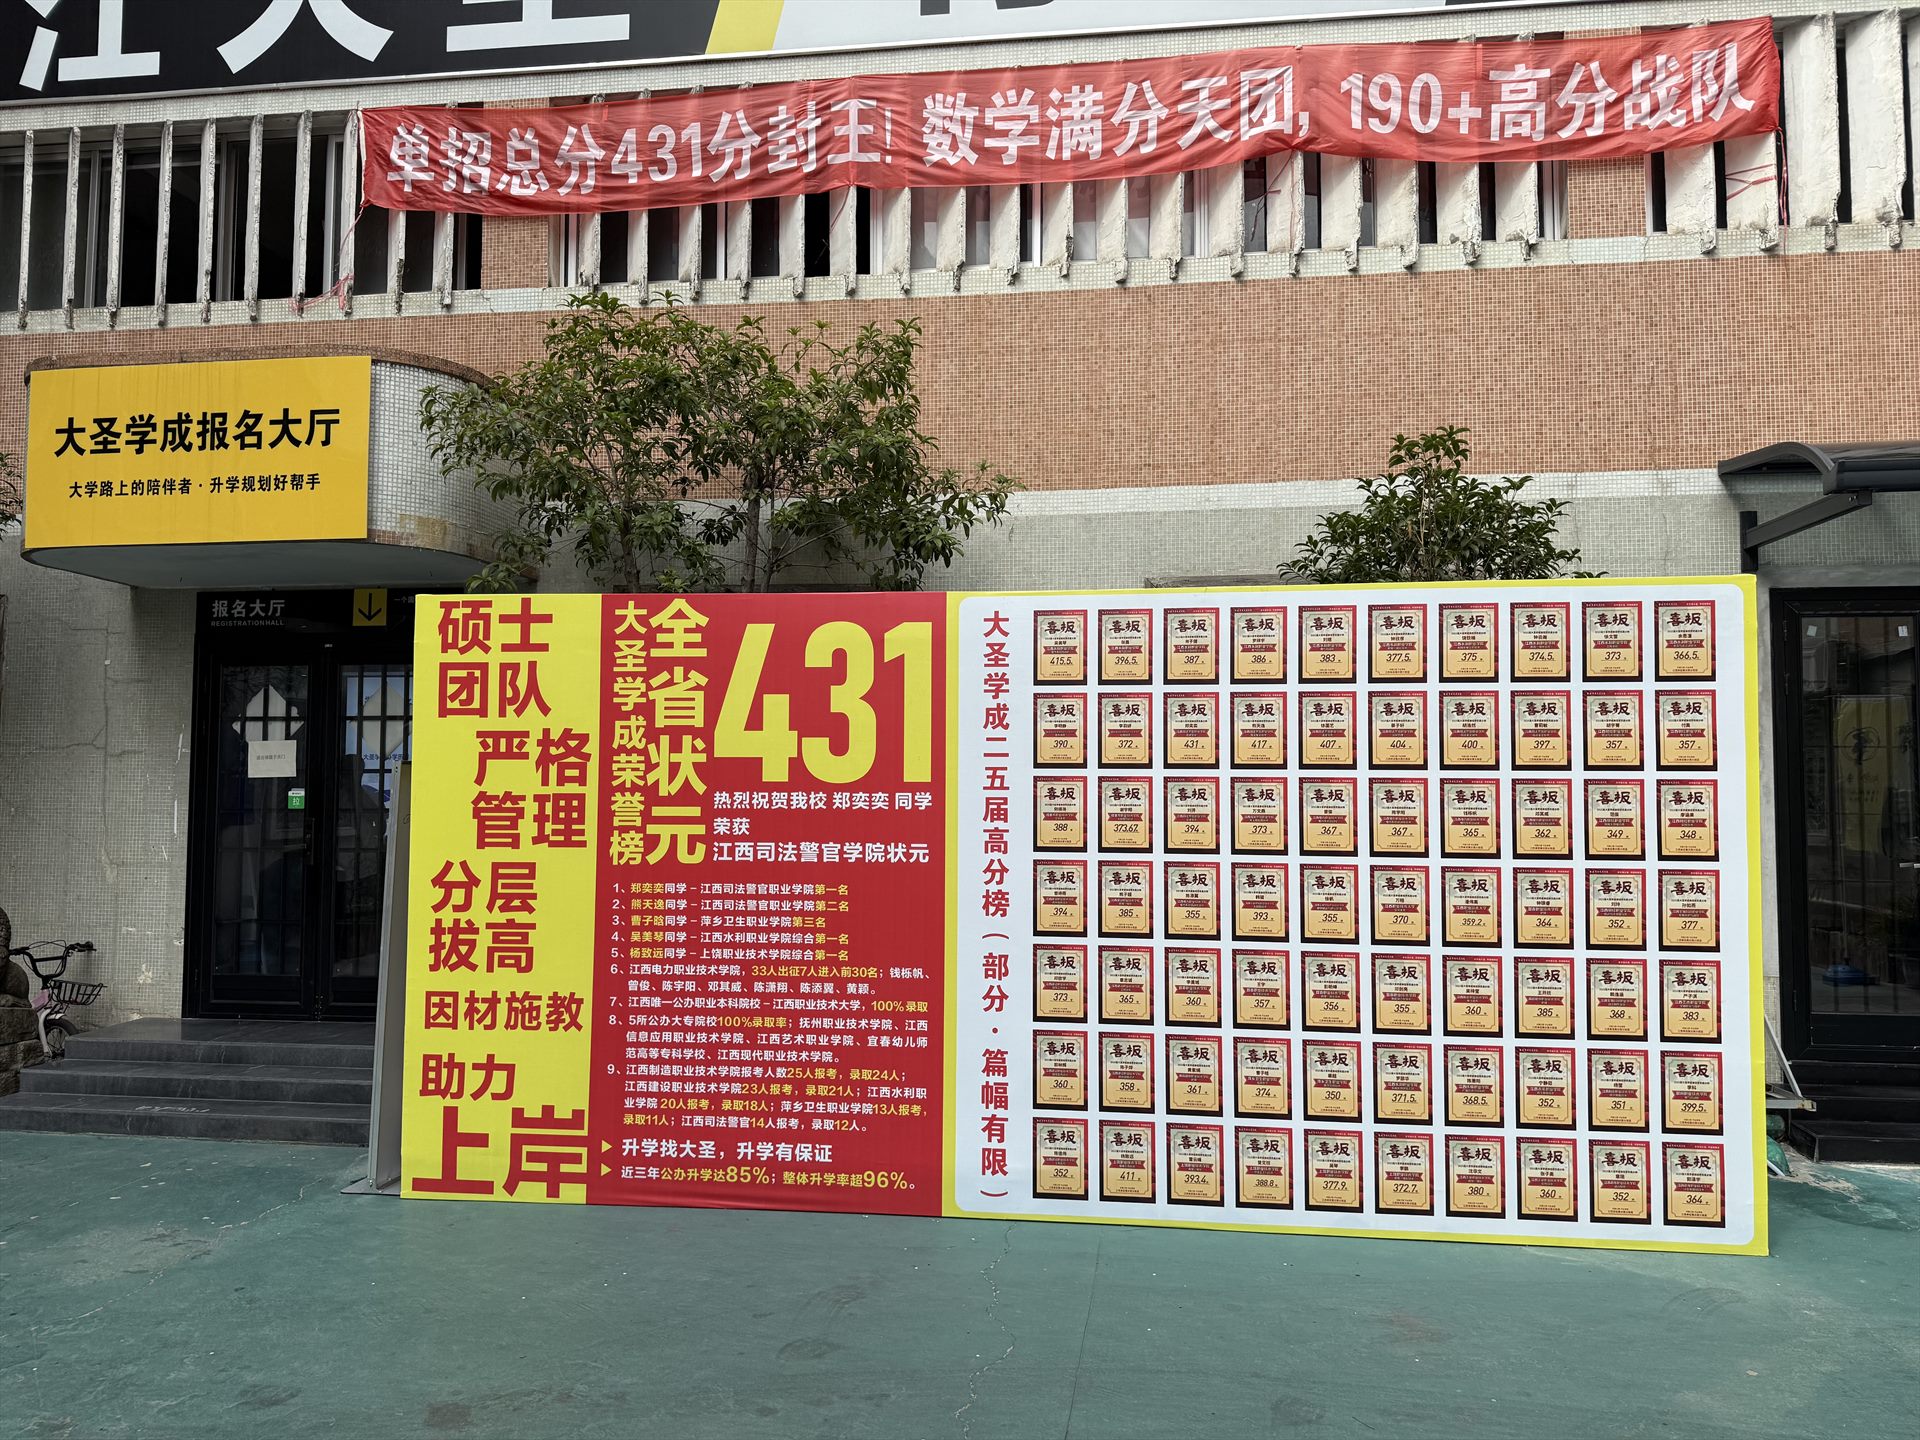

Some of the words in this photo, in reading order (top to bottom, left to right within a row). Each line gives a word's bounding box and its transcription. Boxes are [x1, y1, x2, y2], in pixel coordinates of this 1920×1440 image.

[54, 407, 340, 458] 大圣学成报名大厅
[211, 598, 286, 617] 报名大厅
[437, 597, 554, 655] 硕士
[437, 661, 552, 718] 团队
[713, 620, 933, 784] 431
[474, 727, 593, 788] 严格
[609, 600, 649, 866] 大圣学成荣誉榜
[645, 597, 710, 866] 全省状元
[471, 790, 588, 850] 管理
[712, 816, 751, 836] 荣获
[713, 790, 828, 811] 热烈祝贺我校
[832, 791, 890, 811] 郑奕奕
[894, 791, 933, 811] 同学
[712, 841, 930, 864] 江西司法警官学院状元
[430, 859, 538, 915] 分层
[428, 917, 537, 974] 拔高
[424, 990, 585, 1033] 因材施教
[419, 1052, 517, 1102] 助力
[411, 1104, 589, 1199] 上岸
[621, 1137, 833, 1163] 升学找大圣，升学有保证
